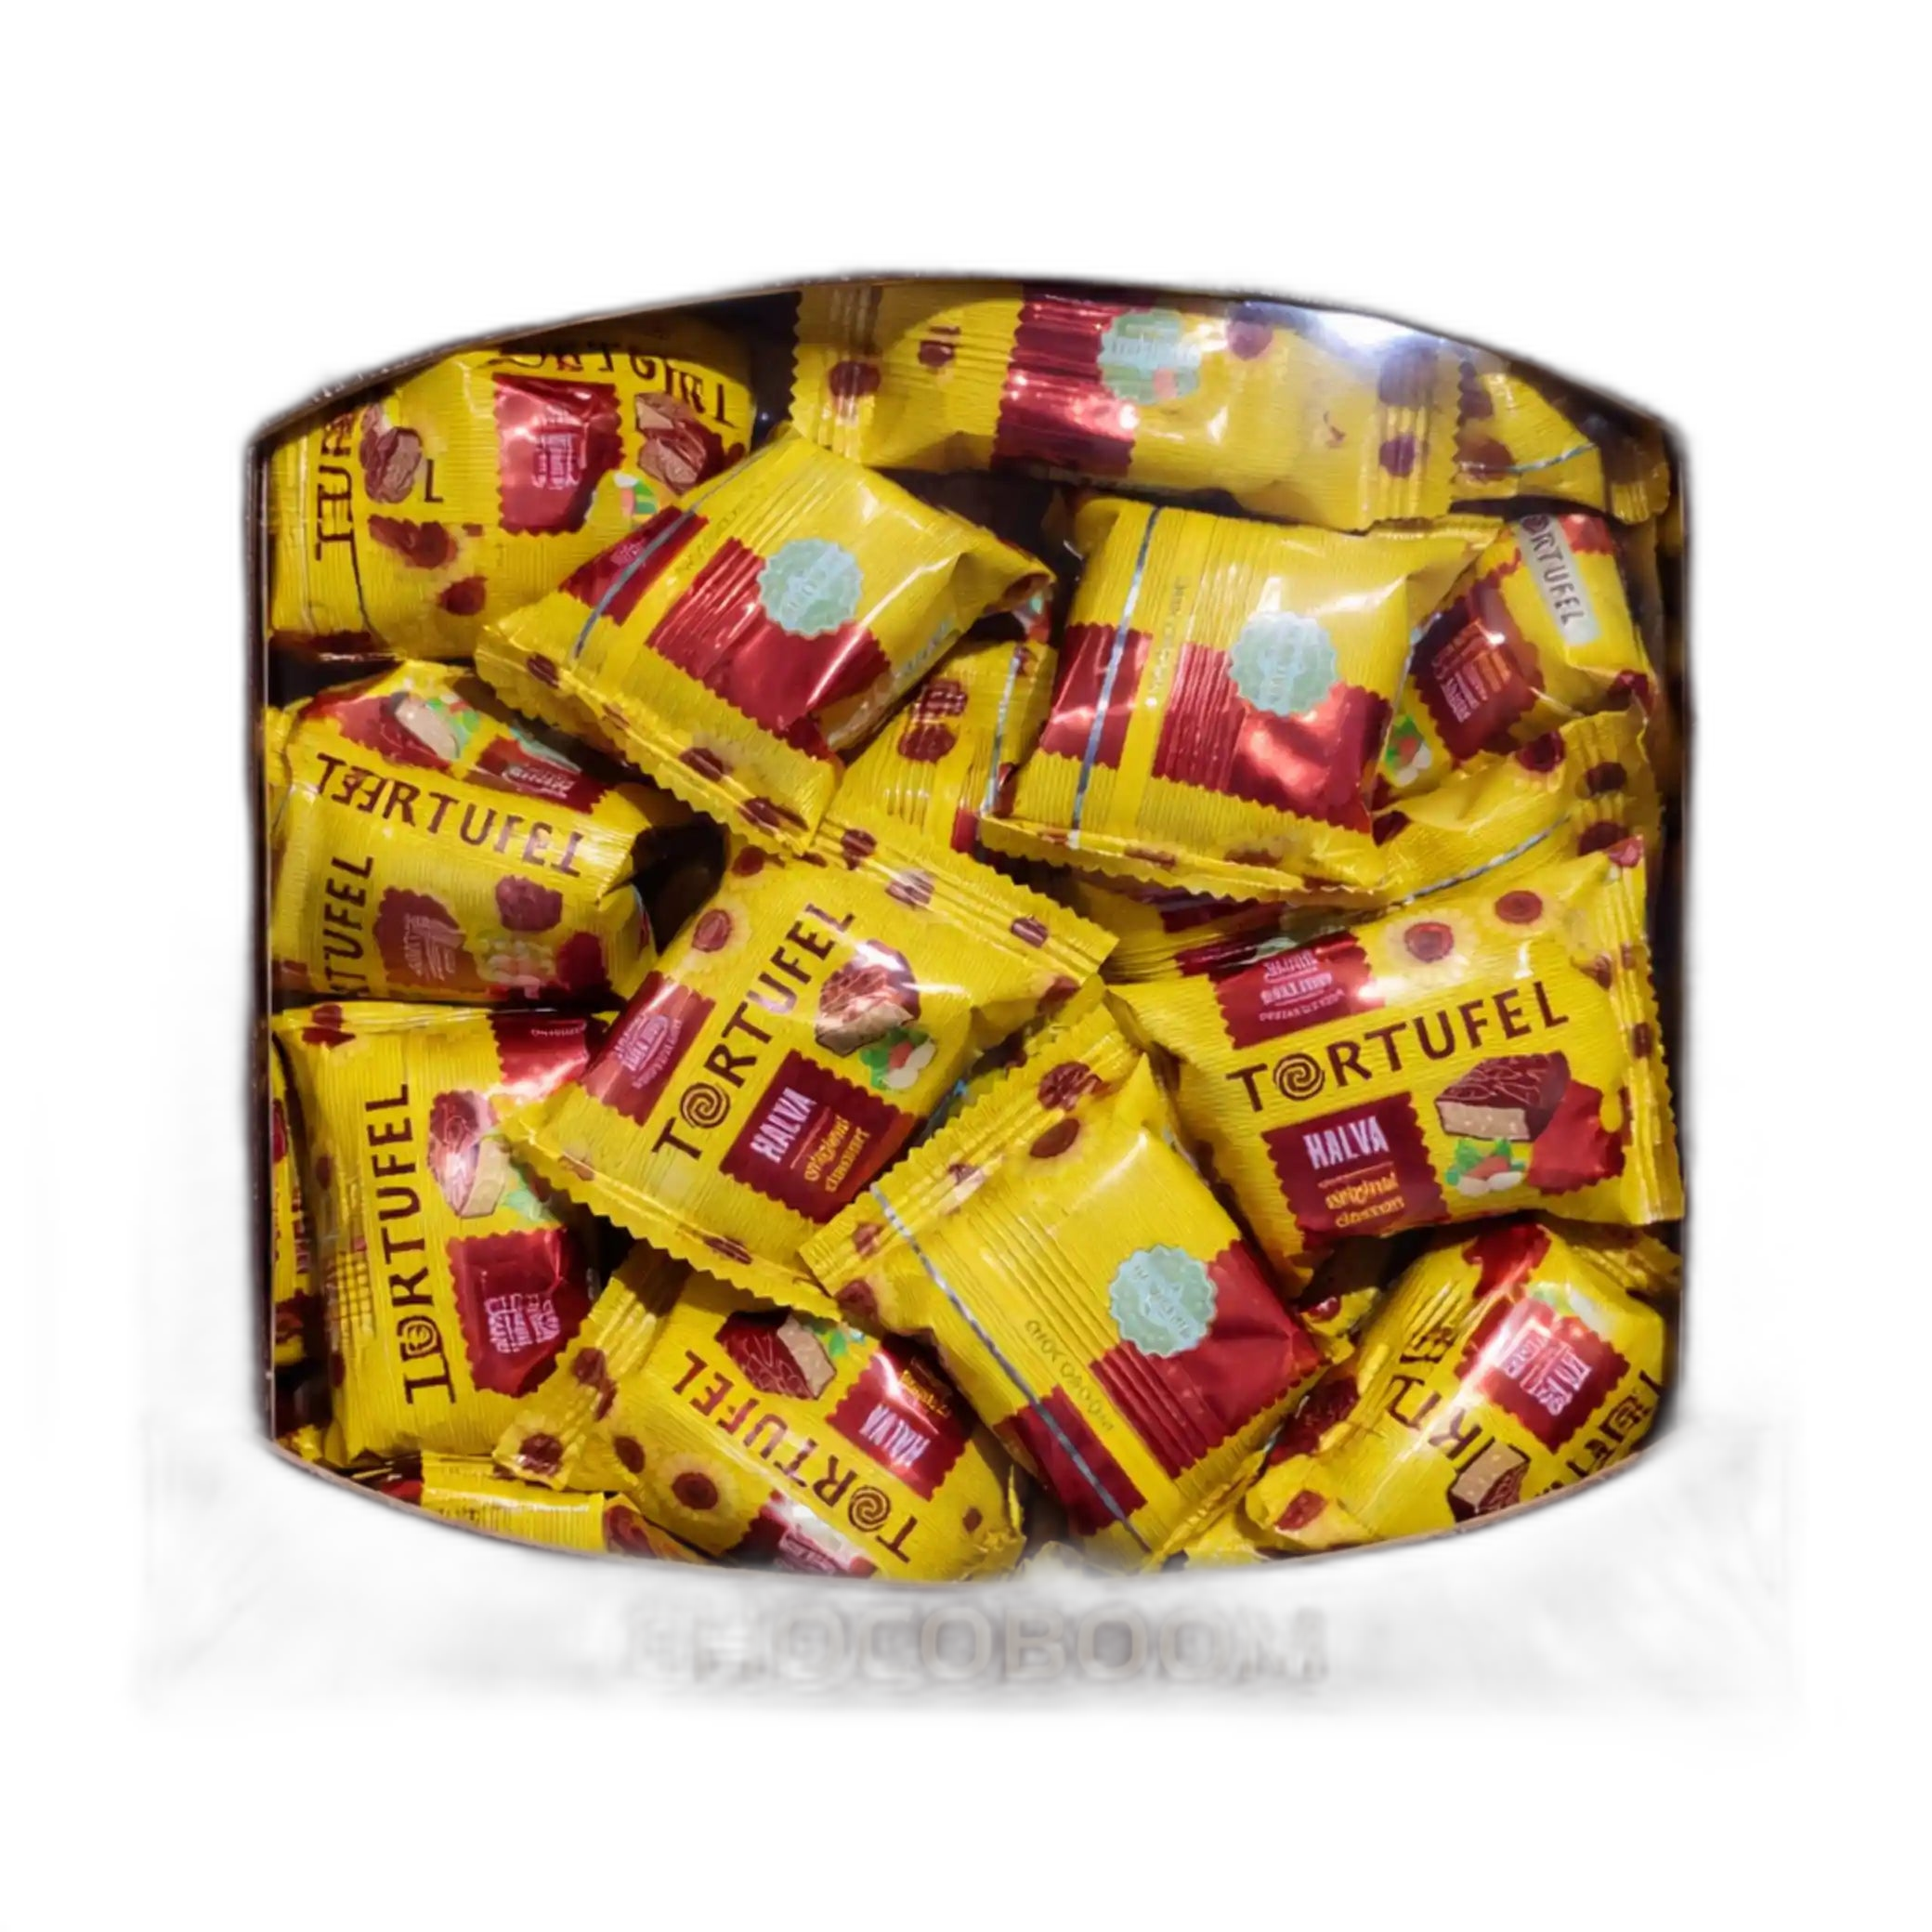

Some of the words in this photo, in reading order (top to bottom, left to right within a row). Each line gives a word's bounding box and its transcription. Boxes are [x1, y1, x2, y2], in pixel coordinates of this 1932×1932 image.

[651, 902, 856, 1162] TORTUFEL
[1226, 981, 1570, 1113] TORTUFEL
[750, 1086, 818, 1164] HALVA
[1302, 1115, 1390, 1170] HALVA
[672, 1350, 919, 1564] TORTUFEL
[857, 1402, 932, 1469] HALVA
[627, 1605, 1323, 1680] CHOCOBOOM
